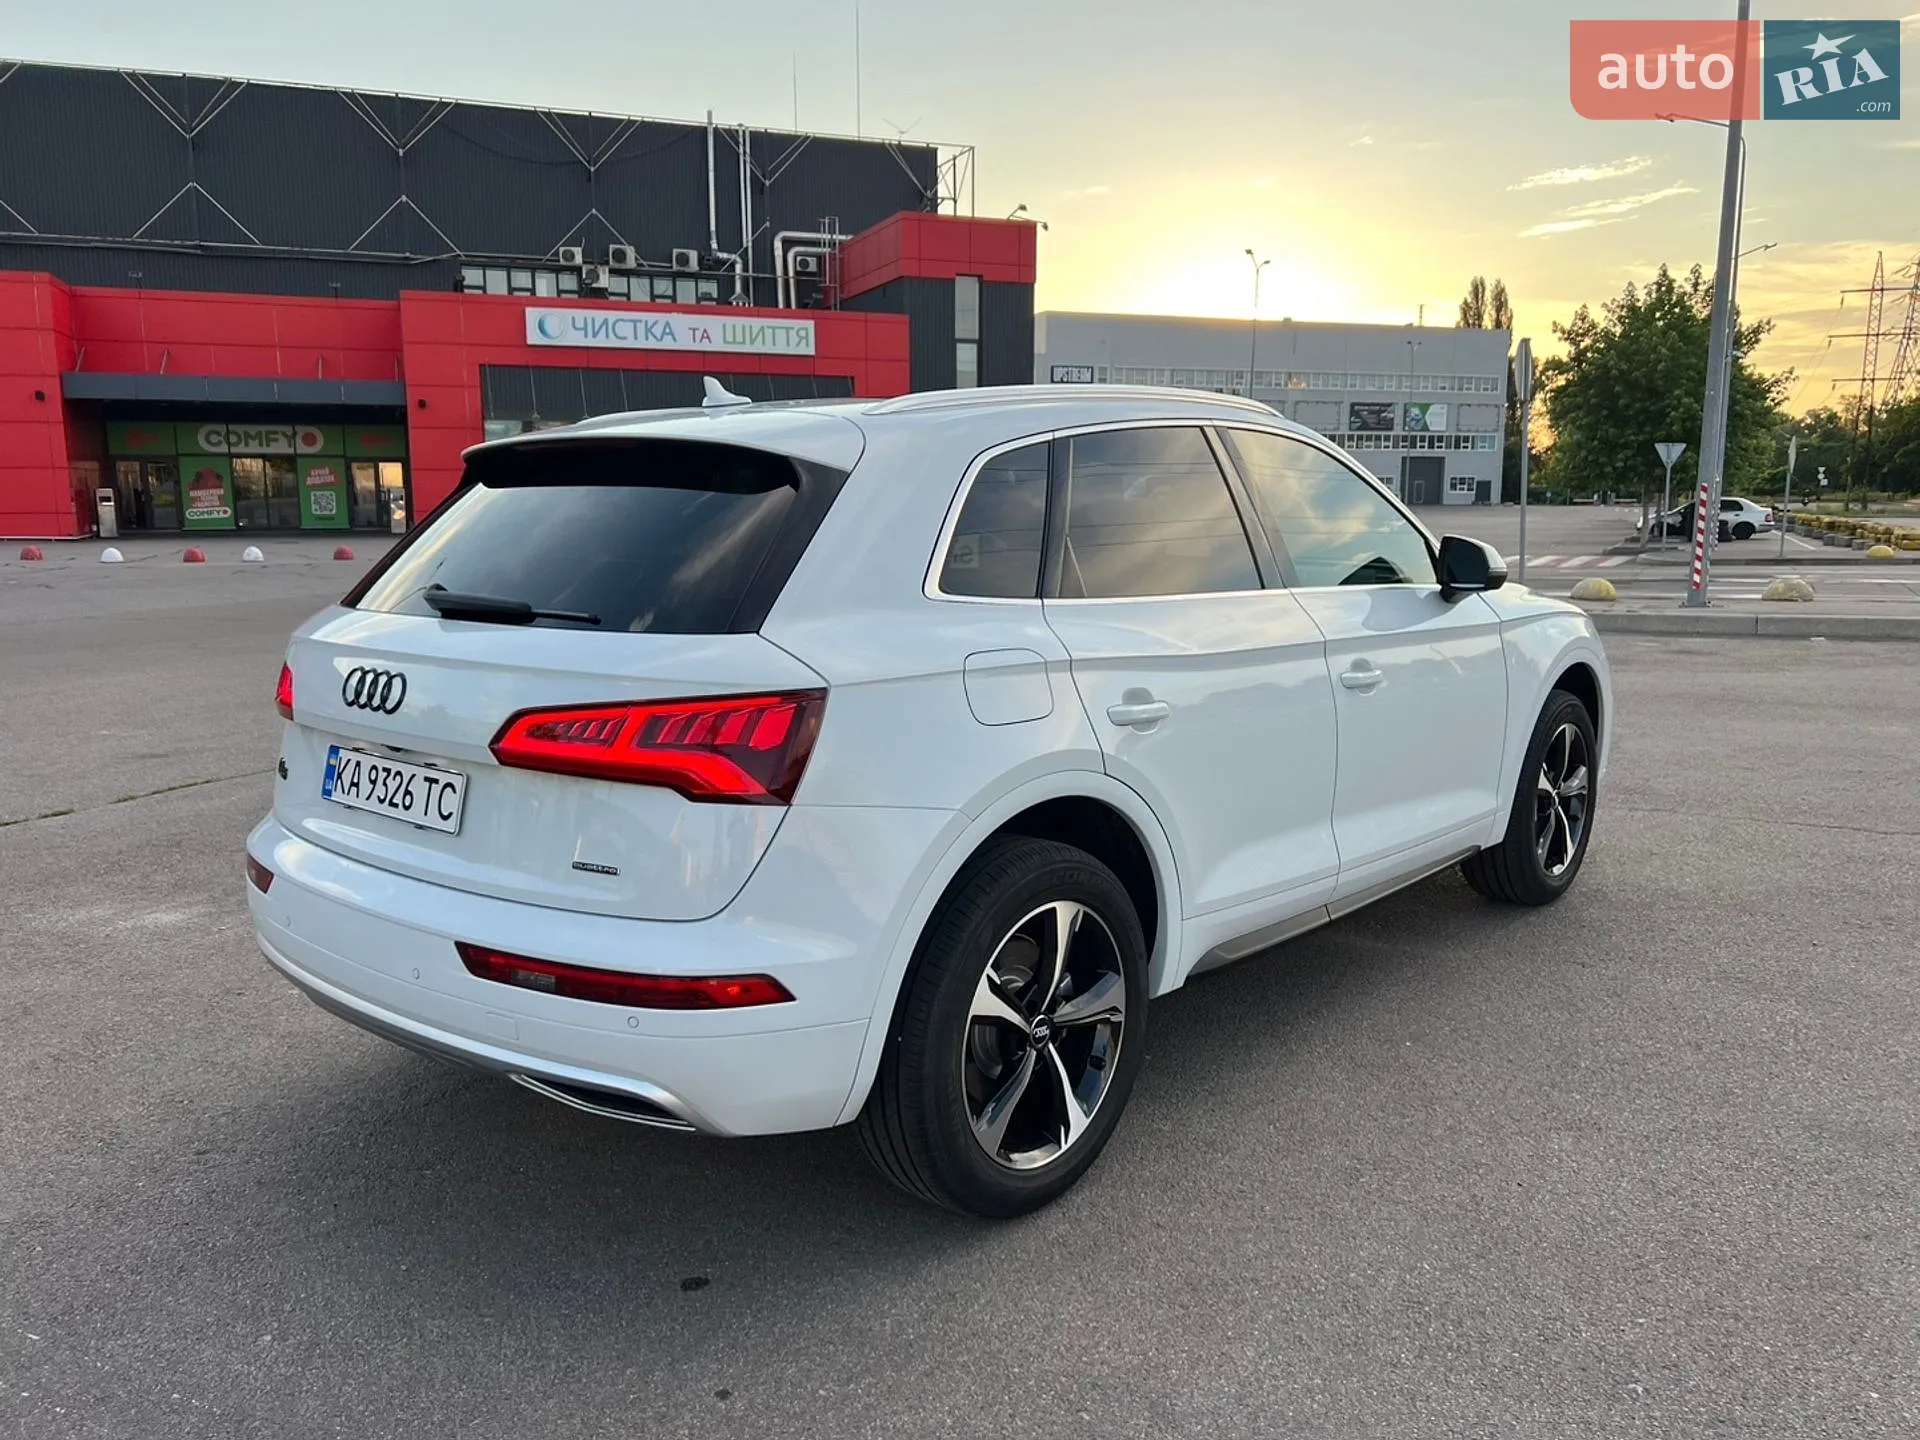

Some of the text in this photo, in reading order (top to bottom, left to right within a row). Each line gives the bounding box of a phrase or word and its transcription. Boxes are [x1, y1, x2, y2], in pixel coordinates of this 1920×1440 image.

[571, 316, 677, 343] ЧИСТКА
[722, 323, 810, 348] ШИТТЯ
[204, 429, 297, 448] COMFY
[187, 509, 222, 518] COMFY
[334, 755, 457, 821] KA 9326 TC
